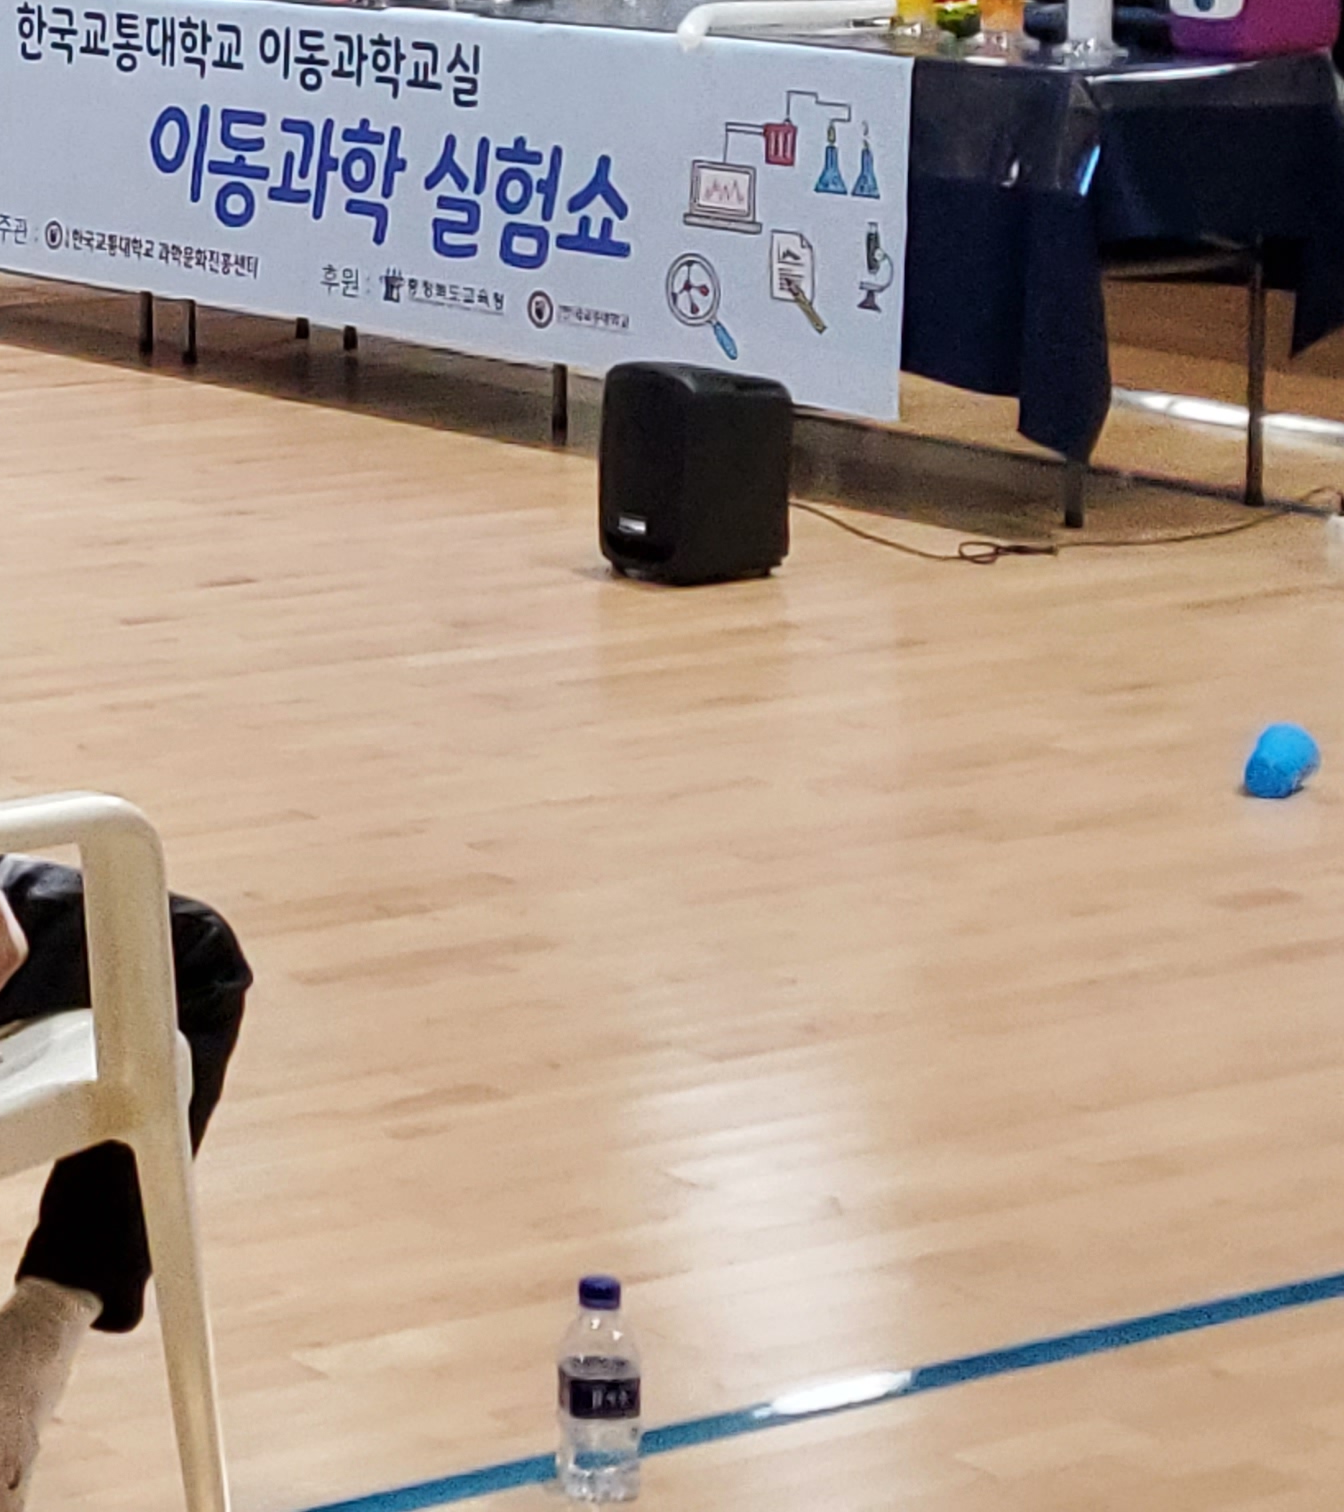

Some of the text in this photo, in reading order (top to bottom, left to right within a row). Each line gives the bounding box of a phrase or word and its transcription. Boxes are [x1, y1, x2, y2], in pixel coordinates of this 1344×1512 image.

[16, 1, 481, 107] 한국교통대학교 이동과학교실
[150, 104, 631, 270] 이동과학 실험쇼
[72, 228, 156, 260] 한국교통대학교
[320, 265, 360, 299] 후원
